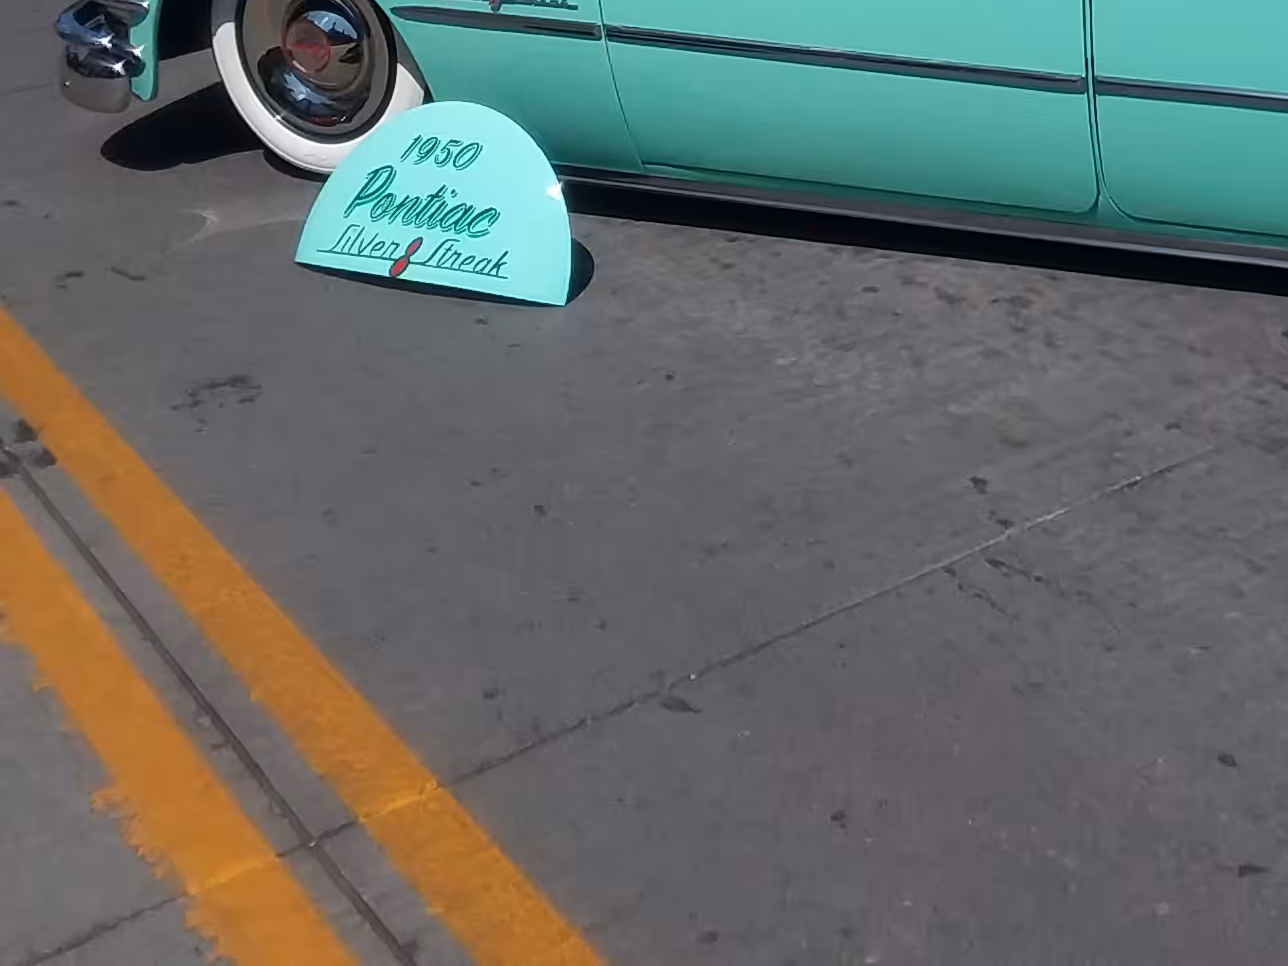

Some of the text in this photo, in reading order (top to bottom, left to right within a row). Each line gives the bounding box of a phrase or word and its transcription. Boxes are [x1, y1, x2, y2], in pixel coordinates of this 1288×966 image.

[400, 134, 483, 170] 1950
[343, 165, 501, 239] Pontiac
[329, 224, 401, 260] Silver
[421, 238, 509, 277] Streak
